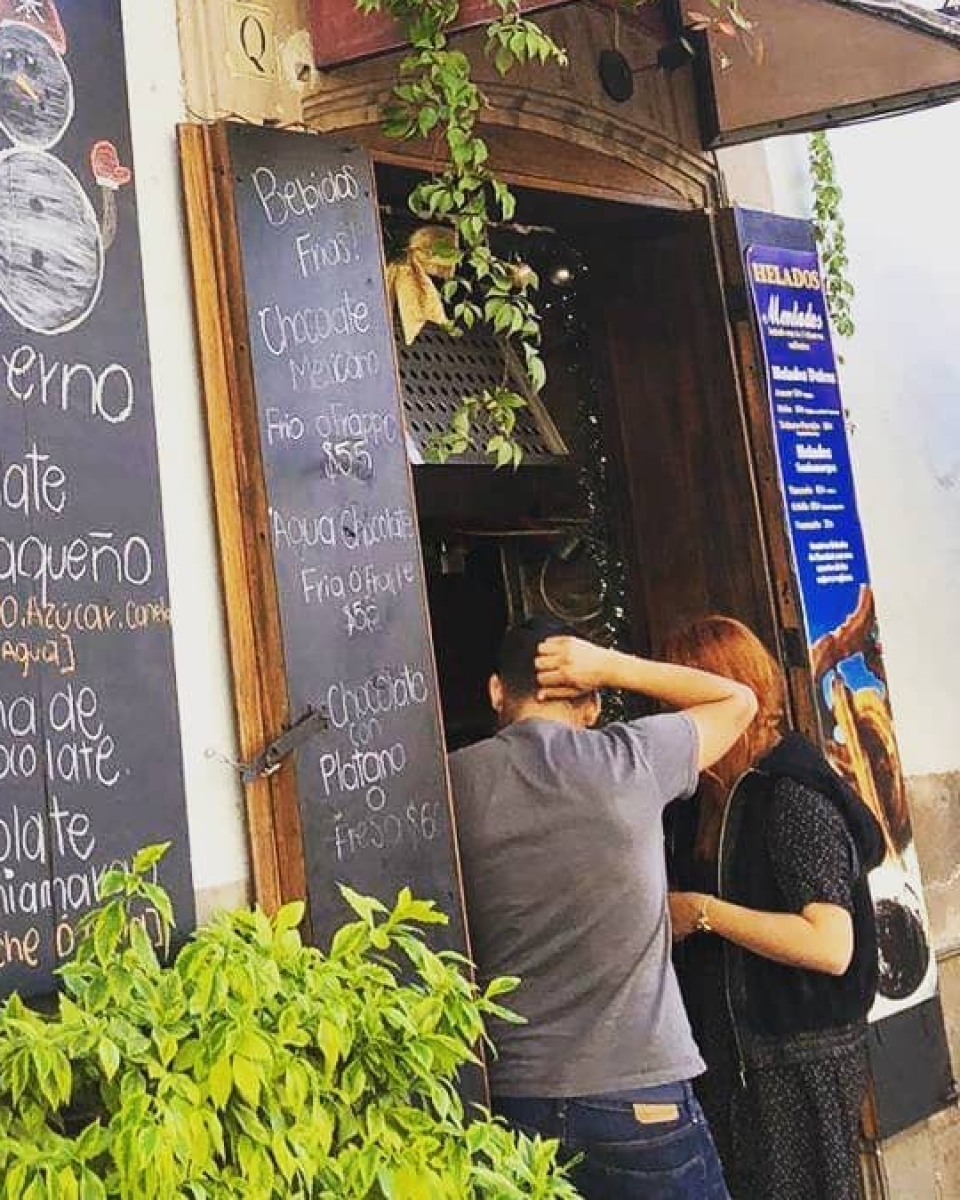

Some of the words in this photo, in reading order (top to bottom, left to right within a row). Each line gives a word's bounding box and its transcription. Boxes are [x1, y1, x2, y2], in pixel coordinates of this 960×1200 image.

[239, 15, 266, 73] Q
[251, 164, 360, 226] Bebidas
[751, 262, 821, 289] HELADOS
[257, 289, 371, 355] Chocolate
[49, 682, 104, 741] de
